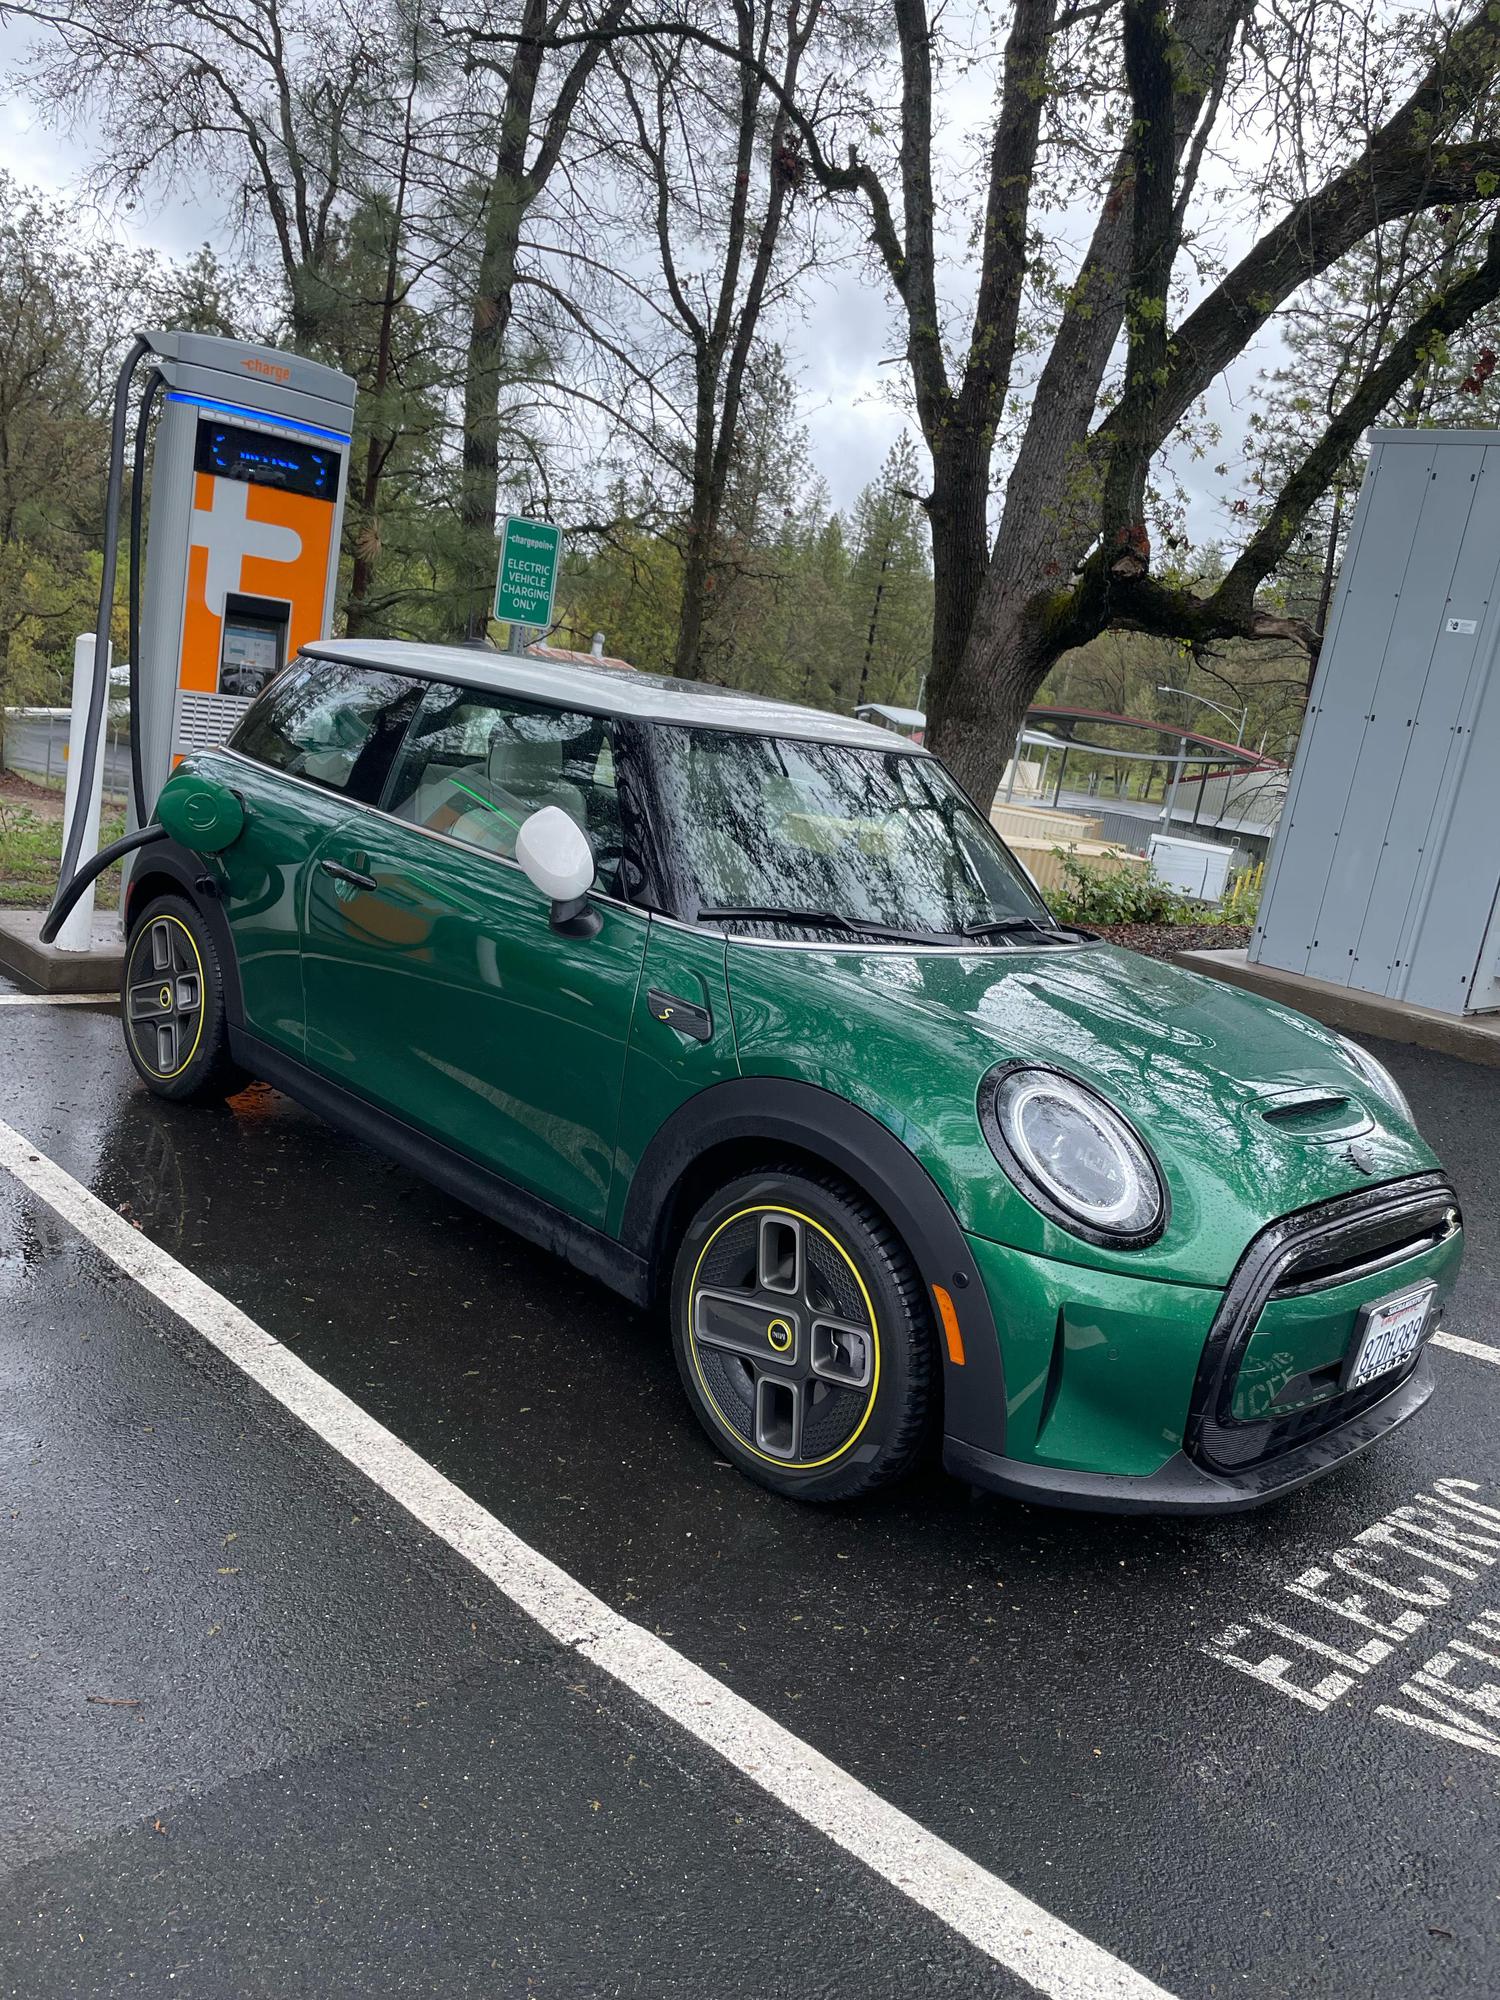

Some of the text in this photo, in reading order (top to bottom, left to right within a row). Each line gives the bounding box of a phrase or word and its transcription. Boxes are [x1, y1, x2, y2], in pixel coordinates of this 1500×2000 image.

[507, 558, 551, 576] ELECTRIC
[509, 571, 547, 588] VEHICLE
[502, 583, 550, 601] CHARGING
[512, 598, 537, 611] ONLY
[1359, 1316, 1422, 1374] 8ZDH389
